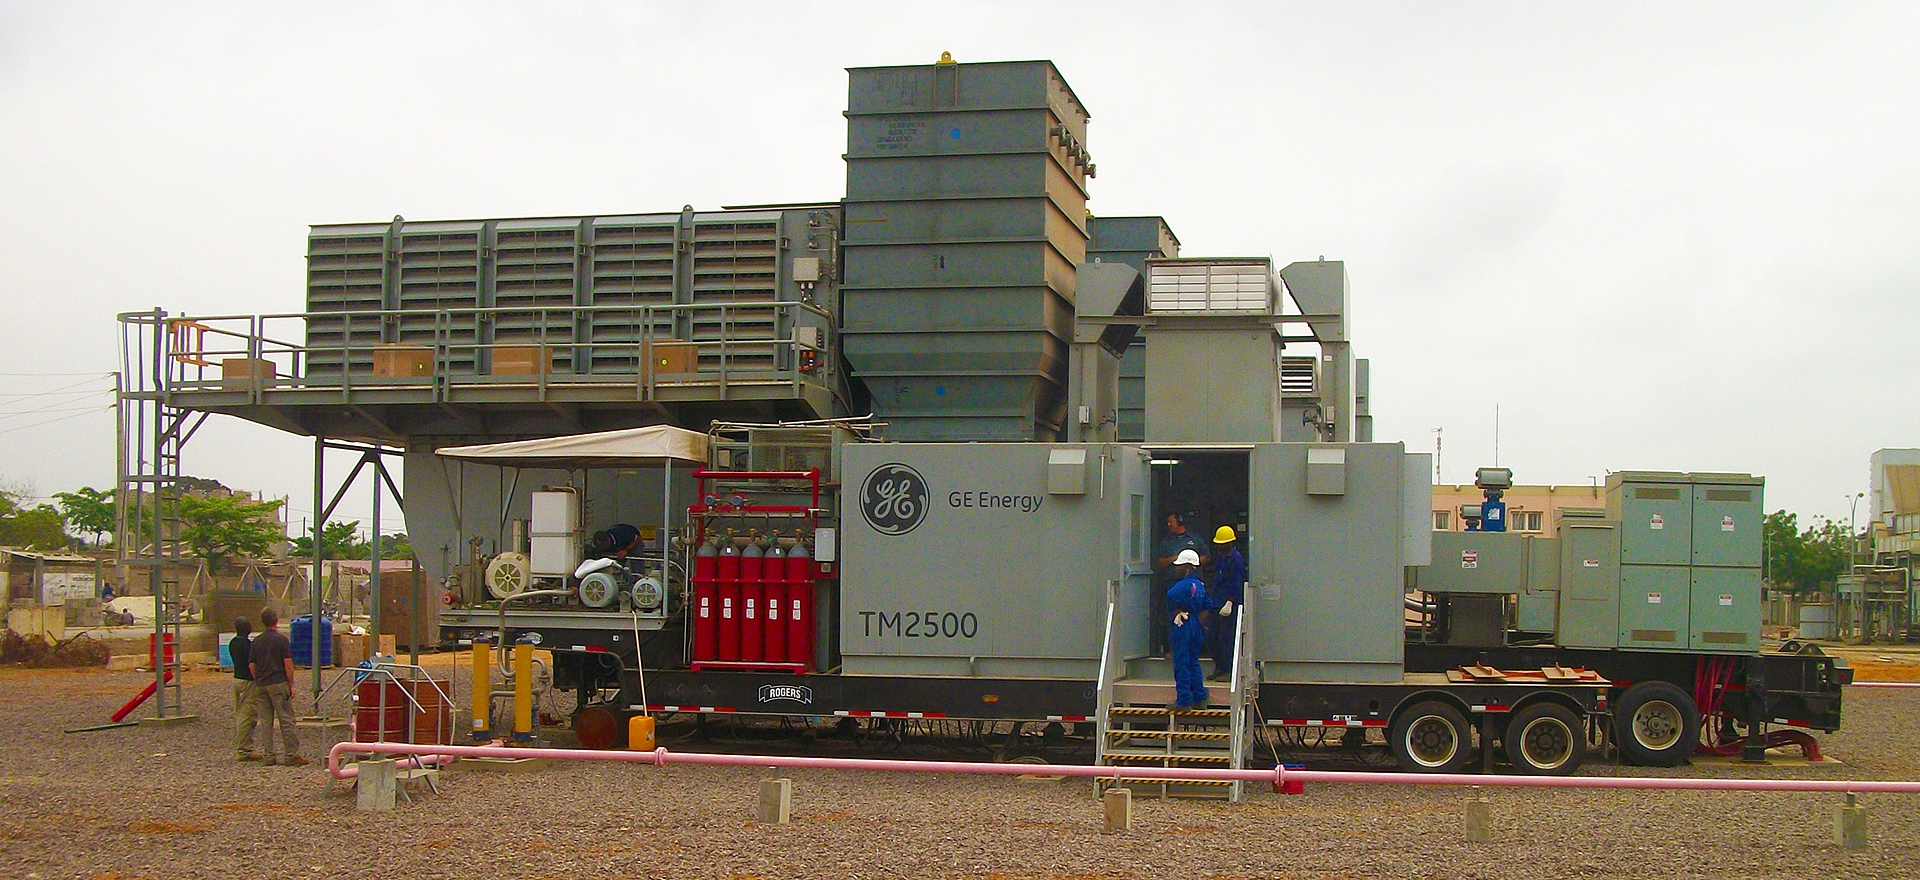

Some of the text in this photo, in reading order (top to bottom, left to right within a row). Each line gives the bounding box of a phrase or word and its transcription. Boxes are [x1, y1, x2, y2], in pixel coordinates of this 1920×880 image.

[948, 491, 1044, 512] GE Energy
[858, 611, 979, 639] TM2500
[769, 687, 801, 699] ROGERS
